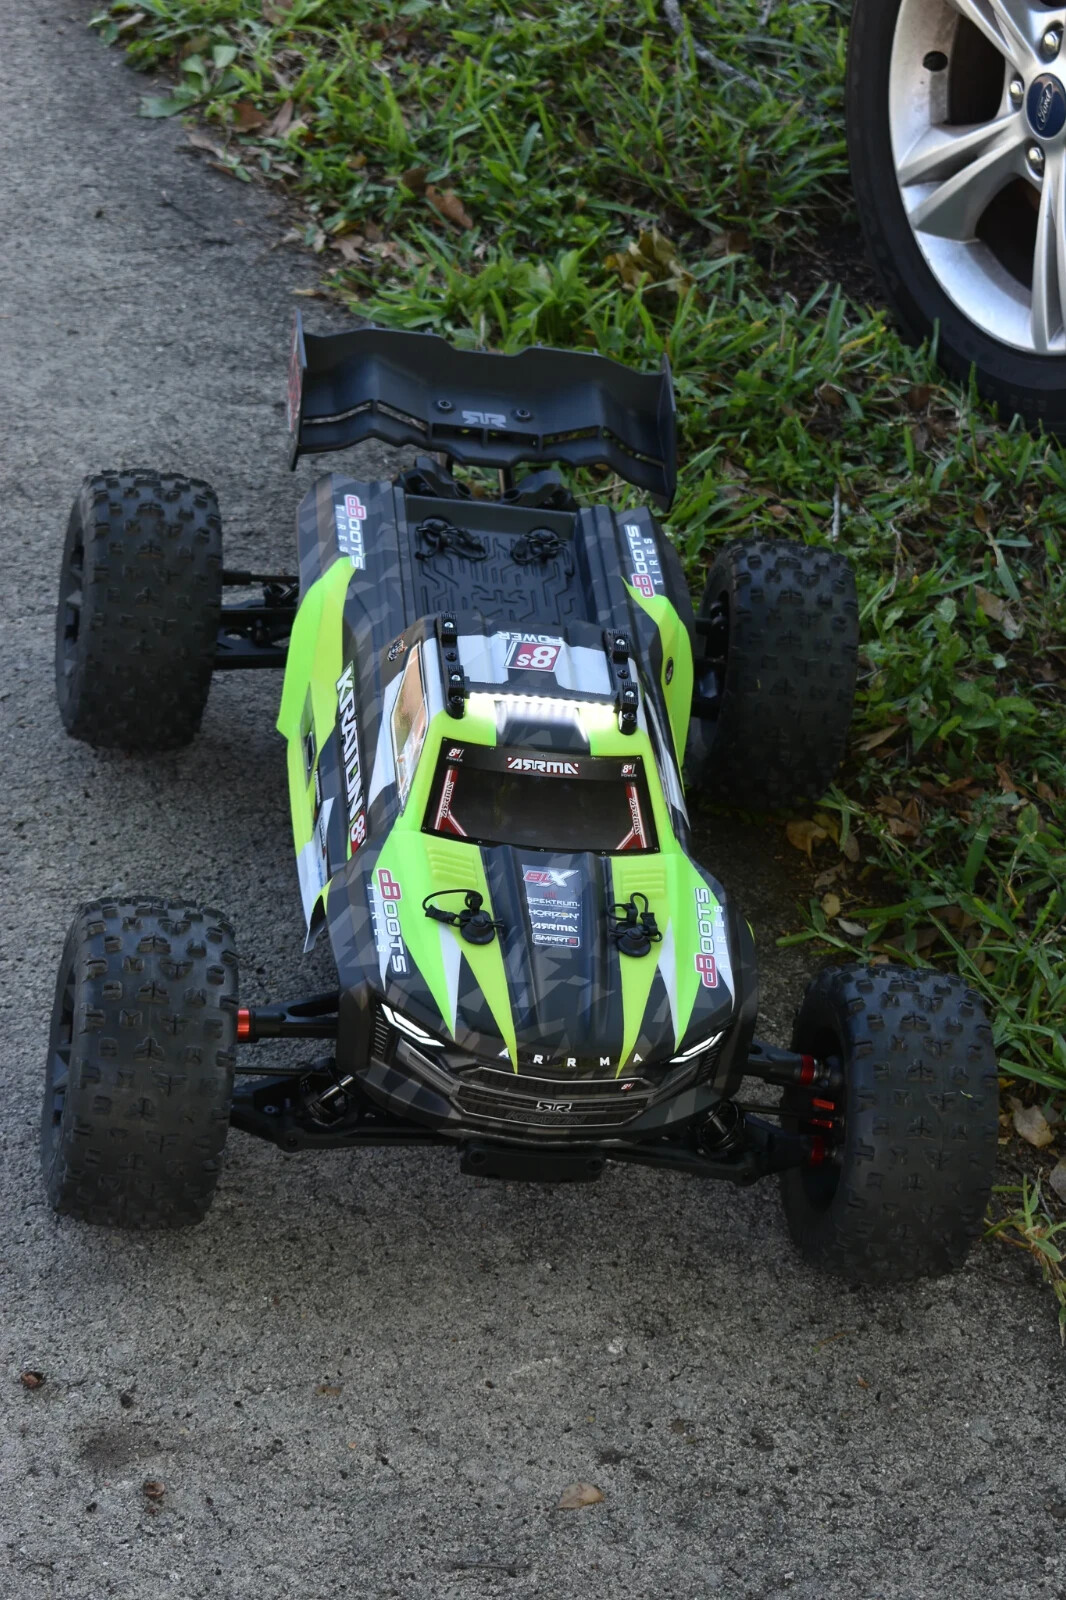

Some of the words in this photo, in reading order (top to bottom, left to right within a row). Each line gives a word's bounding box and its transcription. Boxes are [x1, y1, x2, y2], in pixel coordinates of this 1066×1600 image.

[335, 505, 350, 554] TIRES
[643, 538, 664, 585] TIRES
[497, 630, 564, 645] POWER
[336, 661, 364, 820] KRATON
[367, 884, 387, 952] TIRES
[529, 908, 578, 919] HORIZON
